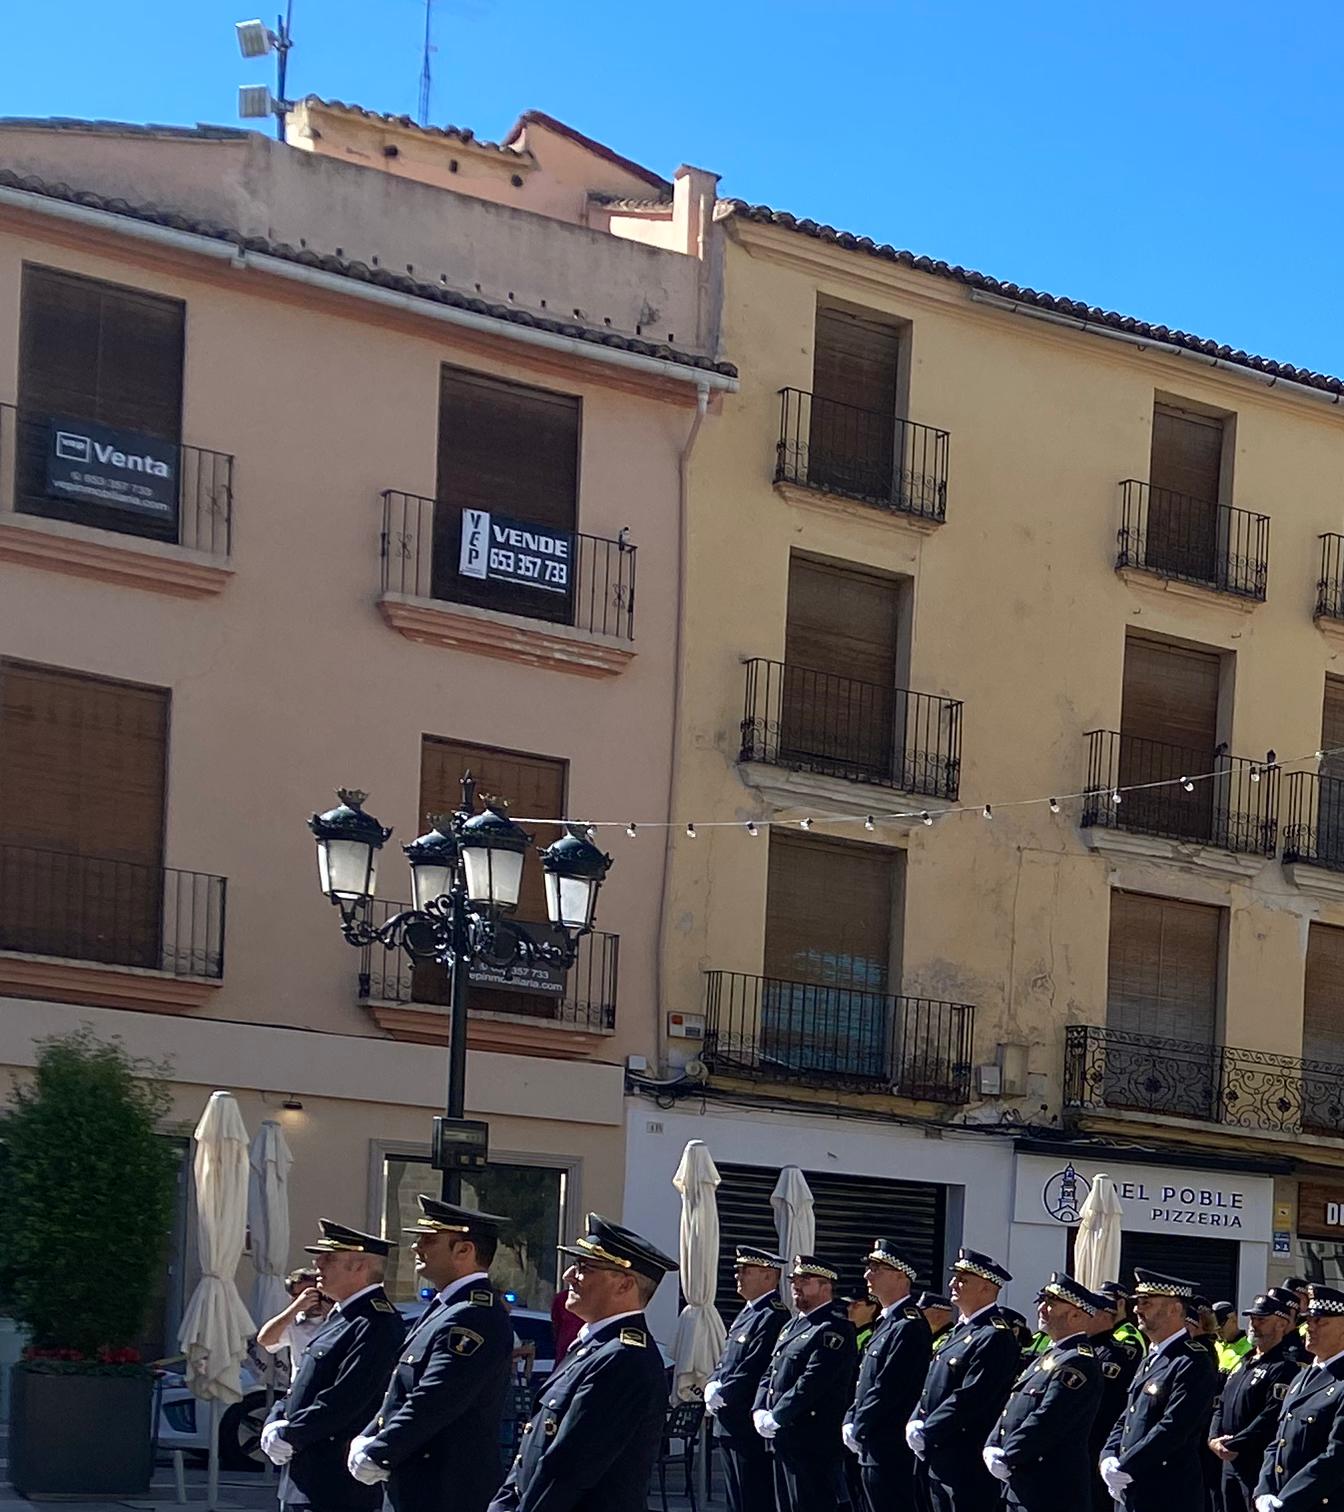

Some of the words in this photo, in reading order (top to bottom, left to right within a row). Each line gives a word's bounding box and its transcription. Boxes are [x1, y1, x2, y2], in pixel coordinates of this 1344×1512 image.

[93, 442, 168, 478] Venta
[469, 513, 481, 565] VEP
[492, 524, 568, 559] VENDE
[490, 548, 514, 573] 653
[517, 554, 541, 578] 357
[544, 560, 567, 584] 733
[1112, 1183, 1149, 1200] EL
[1163, 1187, 1243, 1208] POBLE
[1152, 1208, 1242, 1228] PIZZERIA
